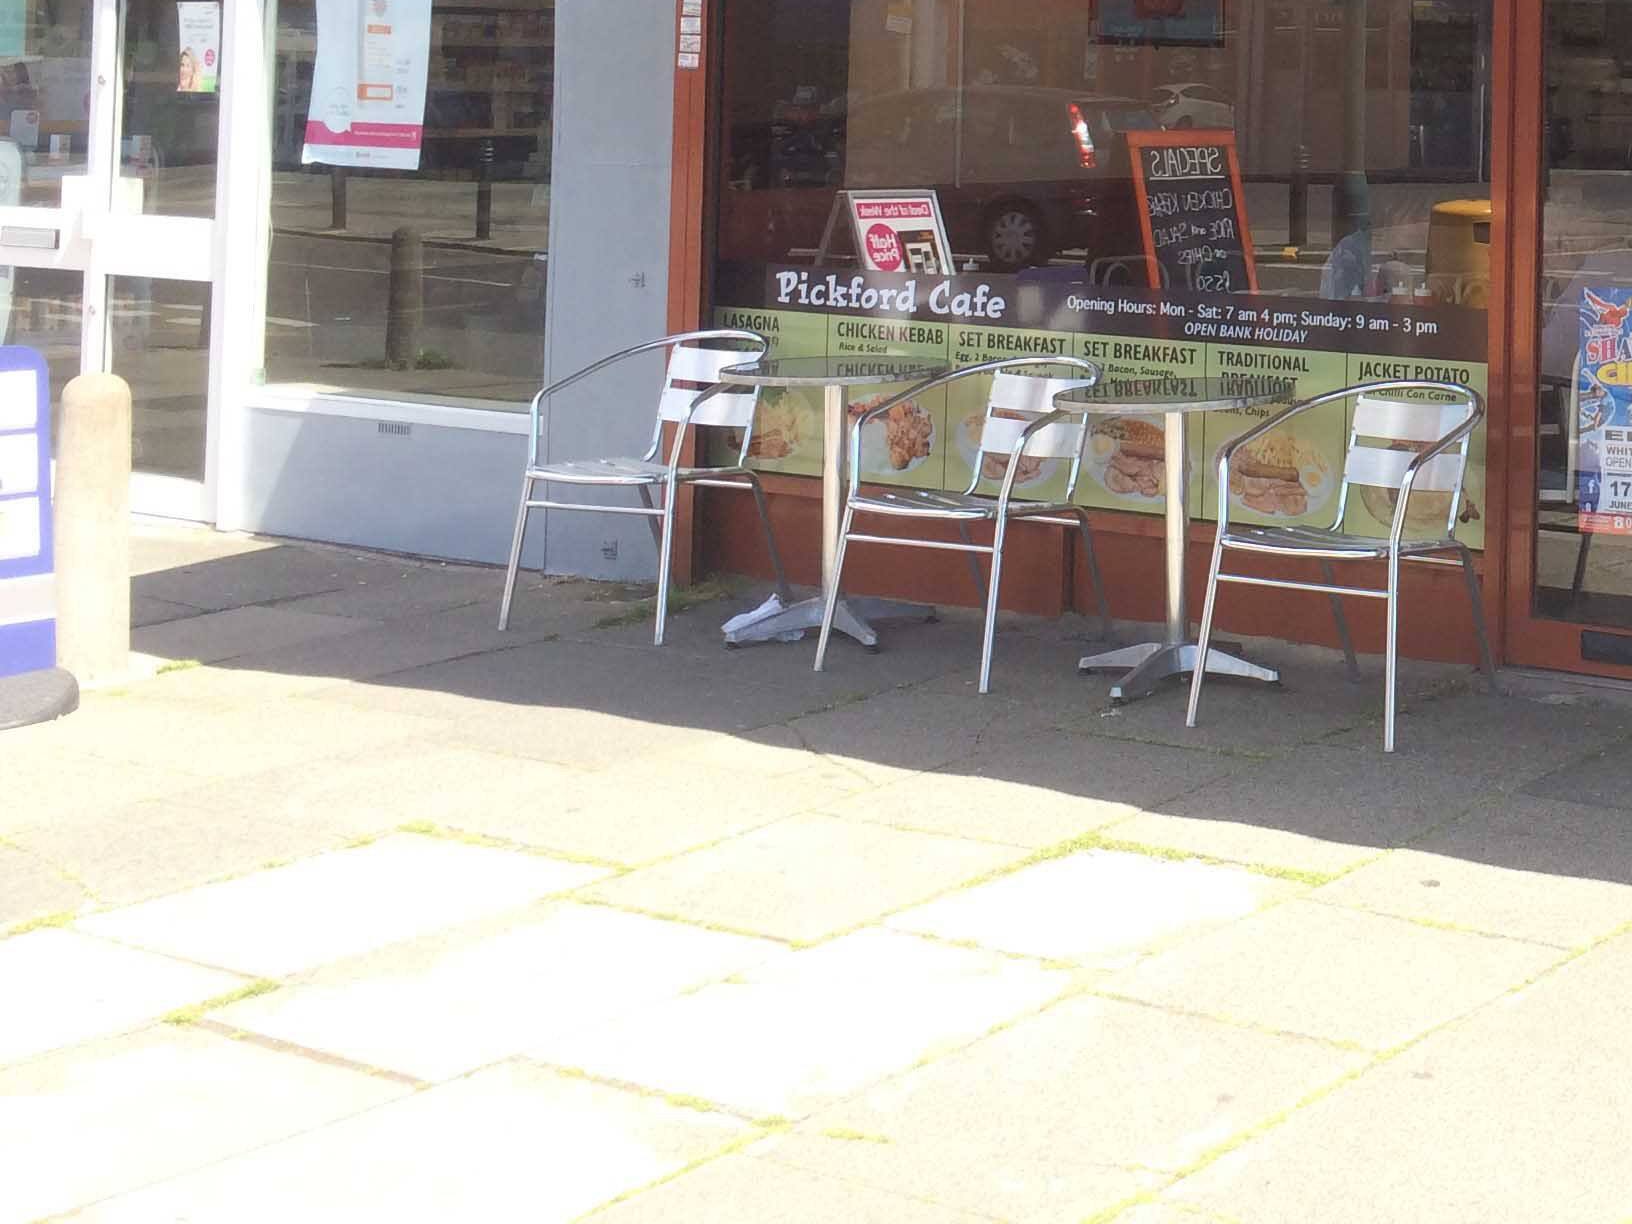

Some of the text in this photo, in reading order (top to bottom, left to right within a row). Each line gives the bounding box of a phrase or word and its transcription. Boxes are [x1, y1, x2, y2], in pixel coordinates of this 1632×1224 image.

[776, 271, 1006, 319] Pickford Cafe
[723, 312, 780, 333] LASAGNA
[1067, 296, 1115, 316] Opening
[1118, 299, 1156, 315] Hours:
[1160, 303, 1186, 317] Mon
[1198, 305, 1221, 320] Sat:
[1225, 306, 1233, 320] 7
[1235, 310, 1258, 322] am
[1260, 308, 1270, 323] 4
[1273, 312, 1297, 327] pm;
[1301, 312, 1352, 332] Sunday:
[1356, 315, 1364, 330] 9
[1366, 319, 1389, 331] am
[1403, 319, 1412, 333] 3
[1415, 322, 1438, 335] pm
[837, 322, 944, 346] CHICKEN KEBAB
[959, 331, 1067, 356] SET BREAKFAST
[1184, 323, 1309, 344] OPEN BANK HOLIDAY
[1083, 341, 1197, 366] SET BREAKFAST
[1218, 350, 1310, 373] TRADITIONAL
[1108, 364, 1137, 376] Bacon,
[1358, 361, 1469, 384] JACKET POTATO
[1407, 390, 1426, 399] Con
[1428, 392, 1457, 402] Carne
[1245, 406, 1270, 418] Chips
[1605, 457, 1632, 468] OPEN
[1610, 481, 1631, 497] 17
[1609, 500, 1632, 511] JUNE
